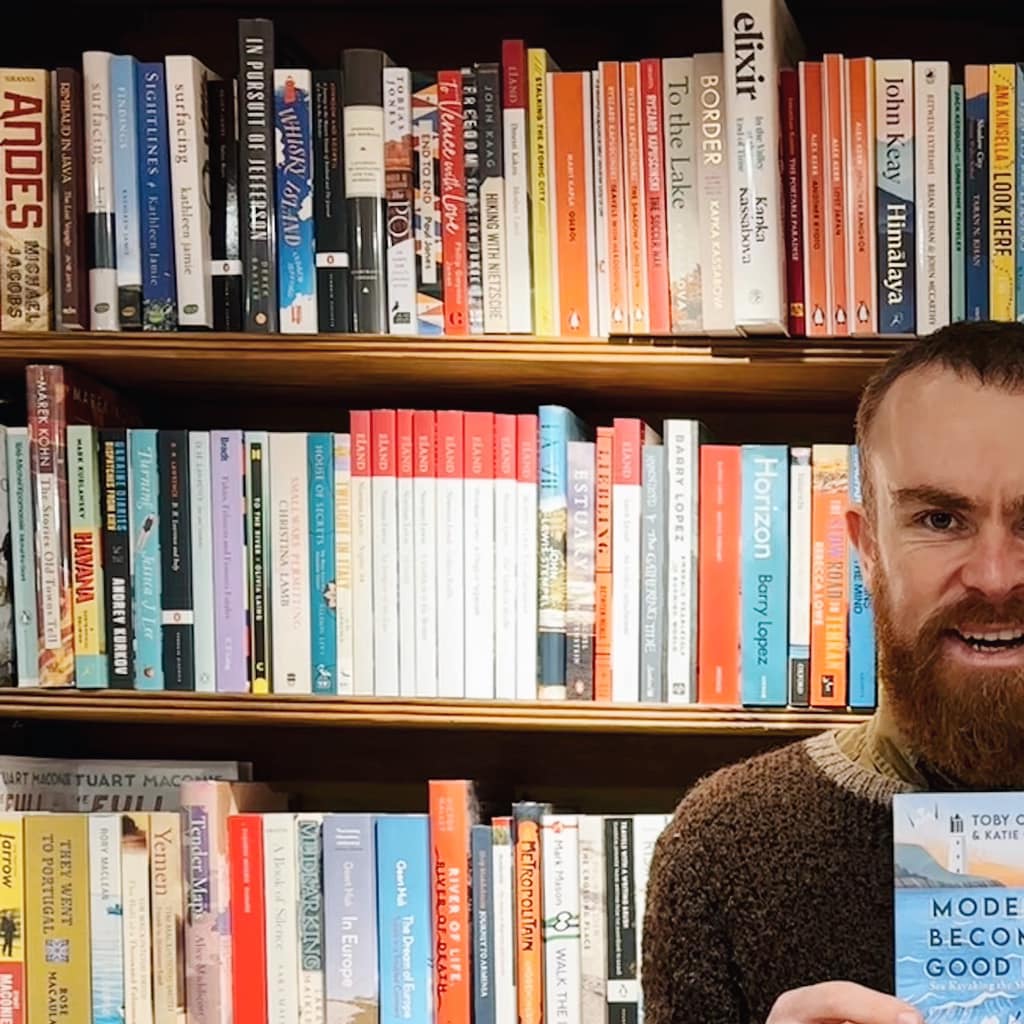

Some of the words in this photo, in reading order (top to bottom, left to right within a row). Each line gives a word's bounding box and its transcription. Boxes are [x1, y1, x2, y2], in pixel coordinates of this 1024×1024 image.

[247, 38, 263, 54] IN
[734, 12, 765, 99] elixir
[247, 61, 264, 127] PURSUIT
[669, 77, 689, 106] To
[884, 78, 904, 126] John
[145, 73, 159, 176] SIGHTLINES
[176, 84, 188, 163] surfacing
[248, 133, 264, 151] OF
[669, 110, 690, 149] the
[701, 75, 720, 165] BORDER
[3, 91, 43, 230] ANDES
[886, 133, 906, 185] Keay
[670, 156, 685, 209] Lake
[993, 173, 1011, 212] LOOK
[486, 193, 498, 230] HIKING
[487, 234, 500, 257] WITH
[993, 217, 1012, 257] HERE
[9, 246, 22, 318] JACOBS
[25, 241, 40, 324] MICHAEL
[488, 261, 502, 318] NIETZSCHE
[36, 380, 49, 426] MAREK
[39, 431, 49, 467] KOHN
[753, 458, 777, 559] Horizon
[73, 532, 94, 604] HAVANA
[113, 577, 127, 621] ANDREY
[754, 574, 772, 616] Barry
[114, 623, 128, 675] KURKOV
[754, 621, 772, 665] Lopez
[972, 815, 1009, 826] TOBY
[972, 830, 980, 839] &
[985, 830, 1019, 840] KATIE
[1, 834, 14, 888] Jarrow
[154, 830, 172, 895] Yemen
[341, 916, 356, 932] In
[341, 938, 358, 987] Europe
[556, 948, 567, 986] WALK
[926, 958, 1011, 976] GOOD
[558, 991, 567, 1016] THE
[996, 982, 1010, 990] the
